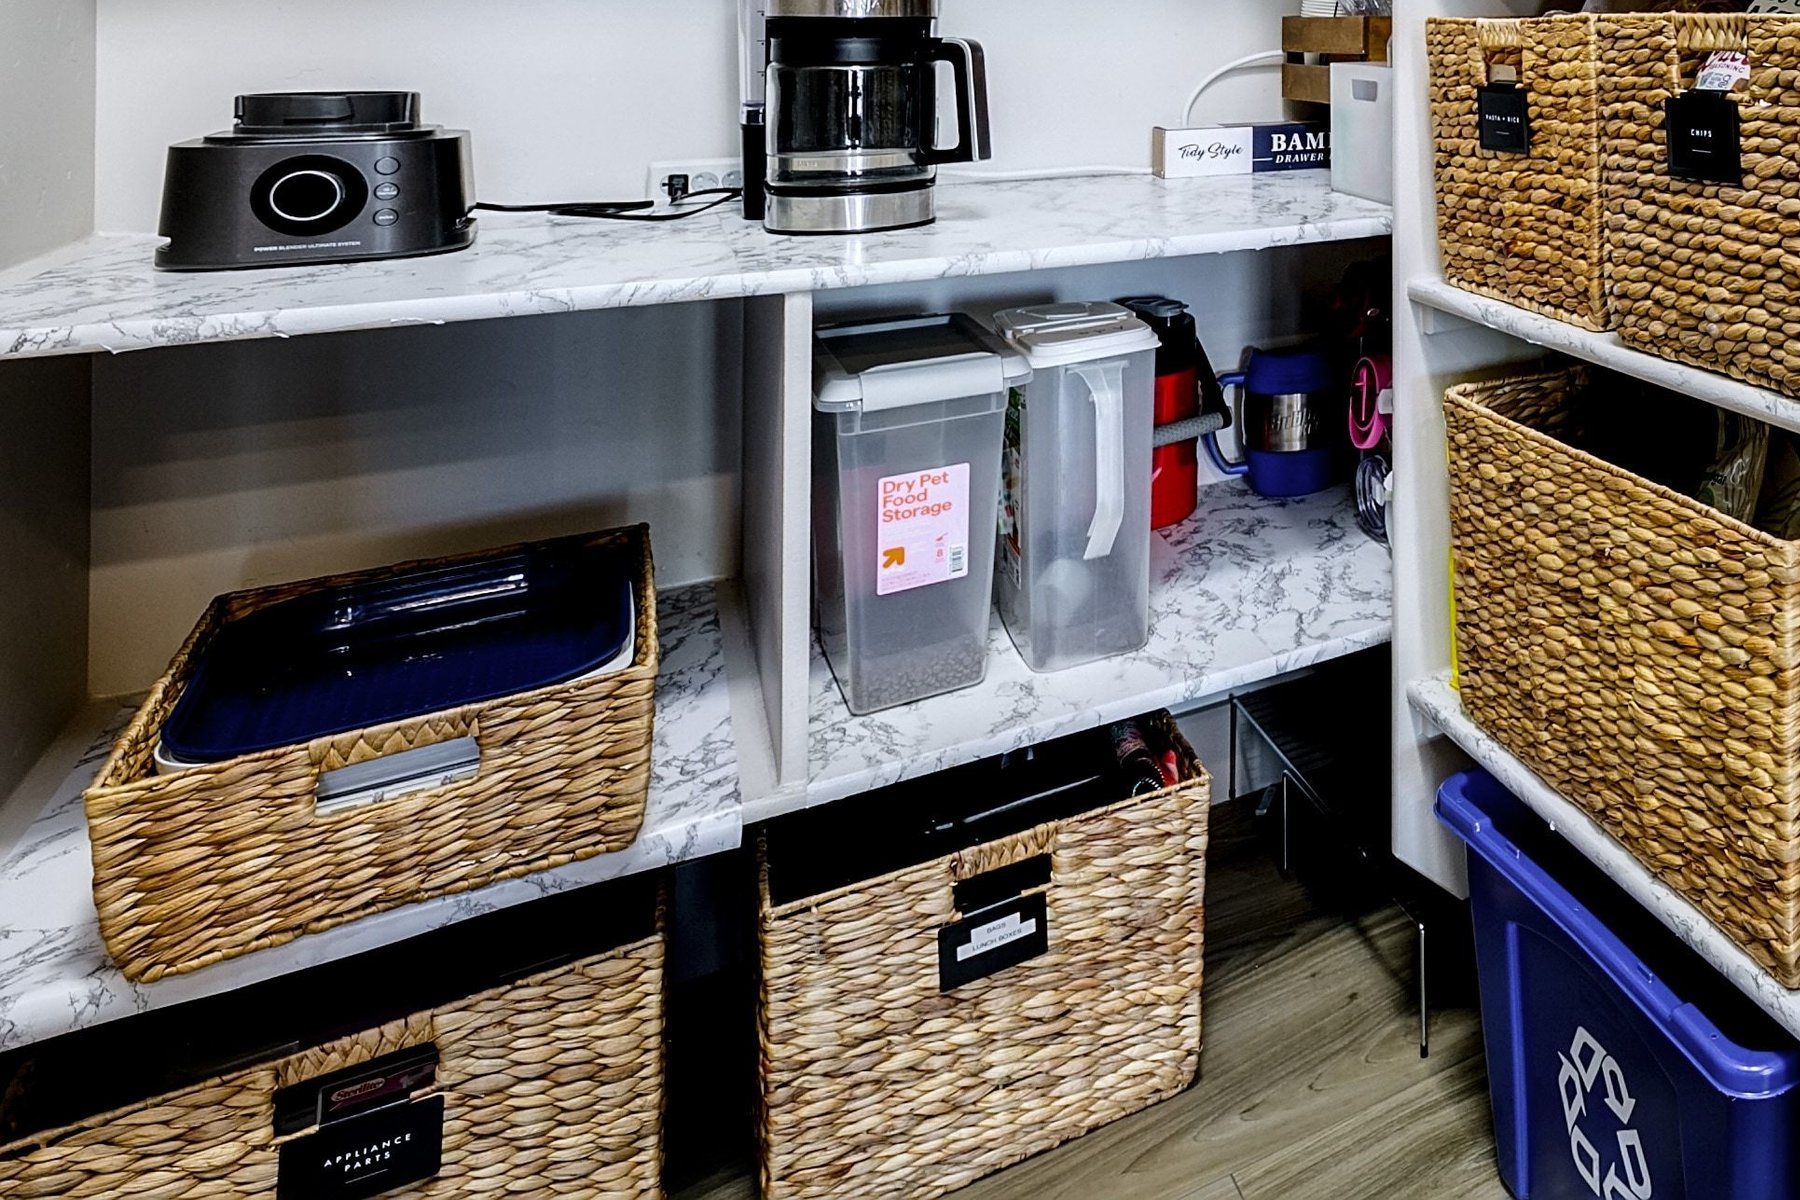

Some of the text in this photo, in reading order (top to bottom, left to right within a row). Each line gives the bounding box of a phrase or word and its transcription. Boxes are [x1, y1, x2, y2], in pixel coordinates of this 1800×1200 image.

[1178, 141, 1244, 162] Tidy Style
[1270, 131, 1332, 153] BAM
[1275, 152, 1325, 164] DRAWER
[883, 471, 950, 495] Dry Pet
[882, 488, 928, 509] Food
[881, 501, 953, 523] Storage
[972, 927, 1023, 952] LUNCH BOXES
[335, 1079, 380, 1100] Sterilite
[323, 1132, 412, 1168] APPLIANCE
[344, 1150, 391, 1173] PARTS
